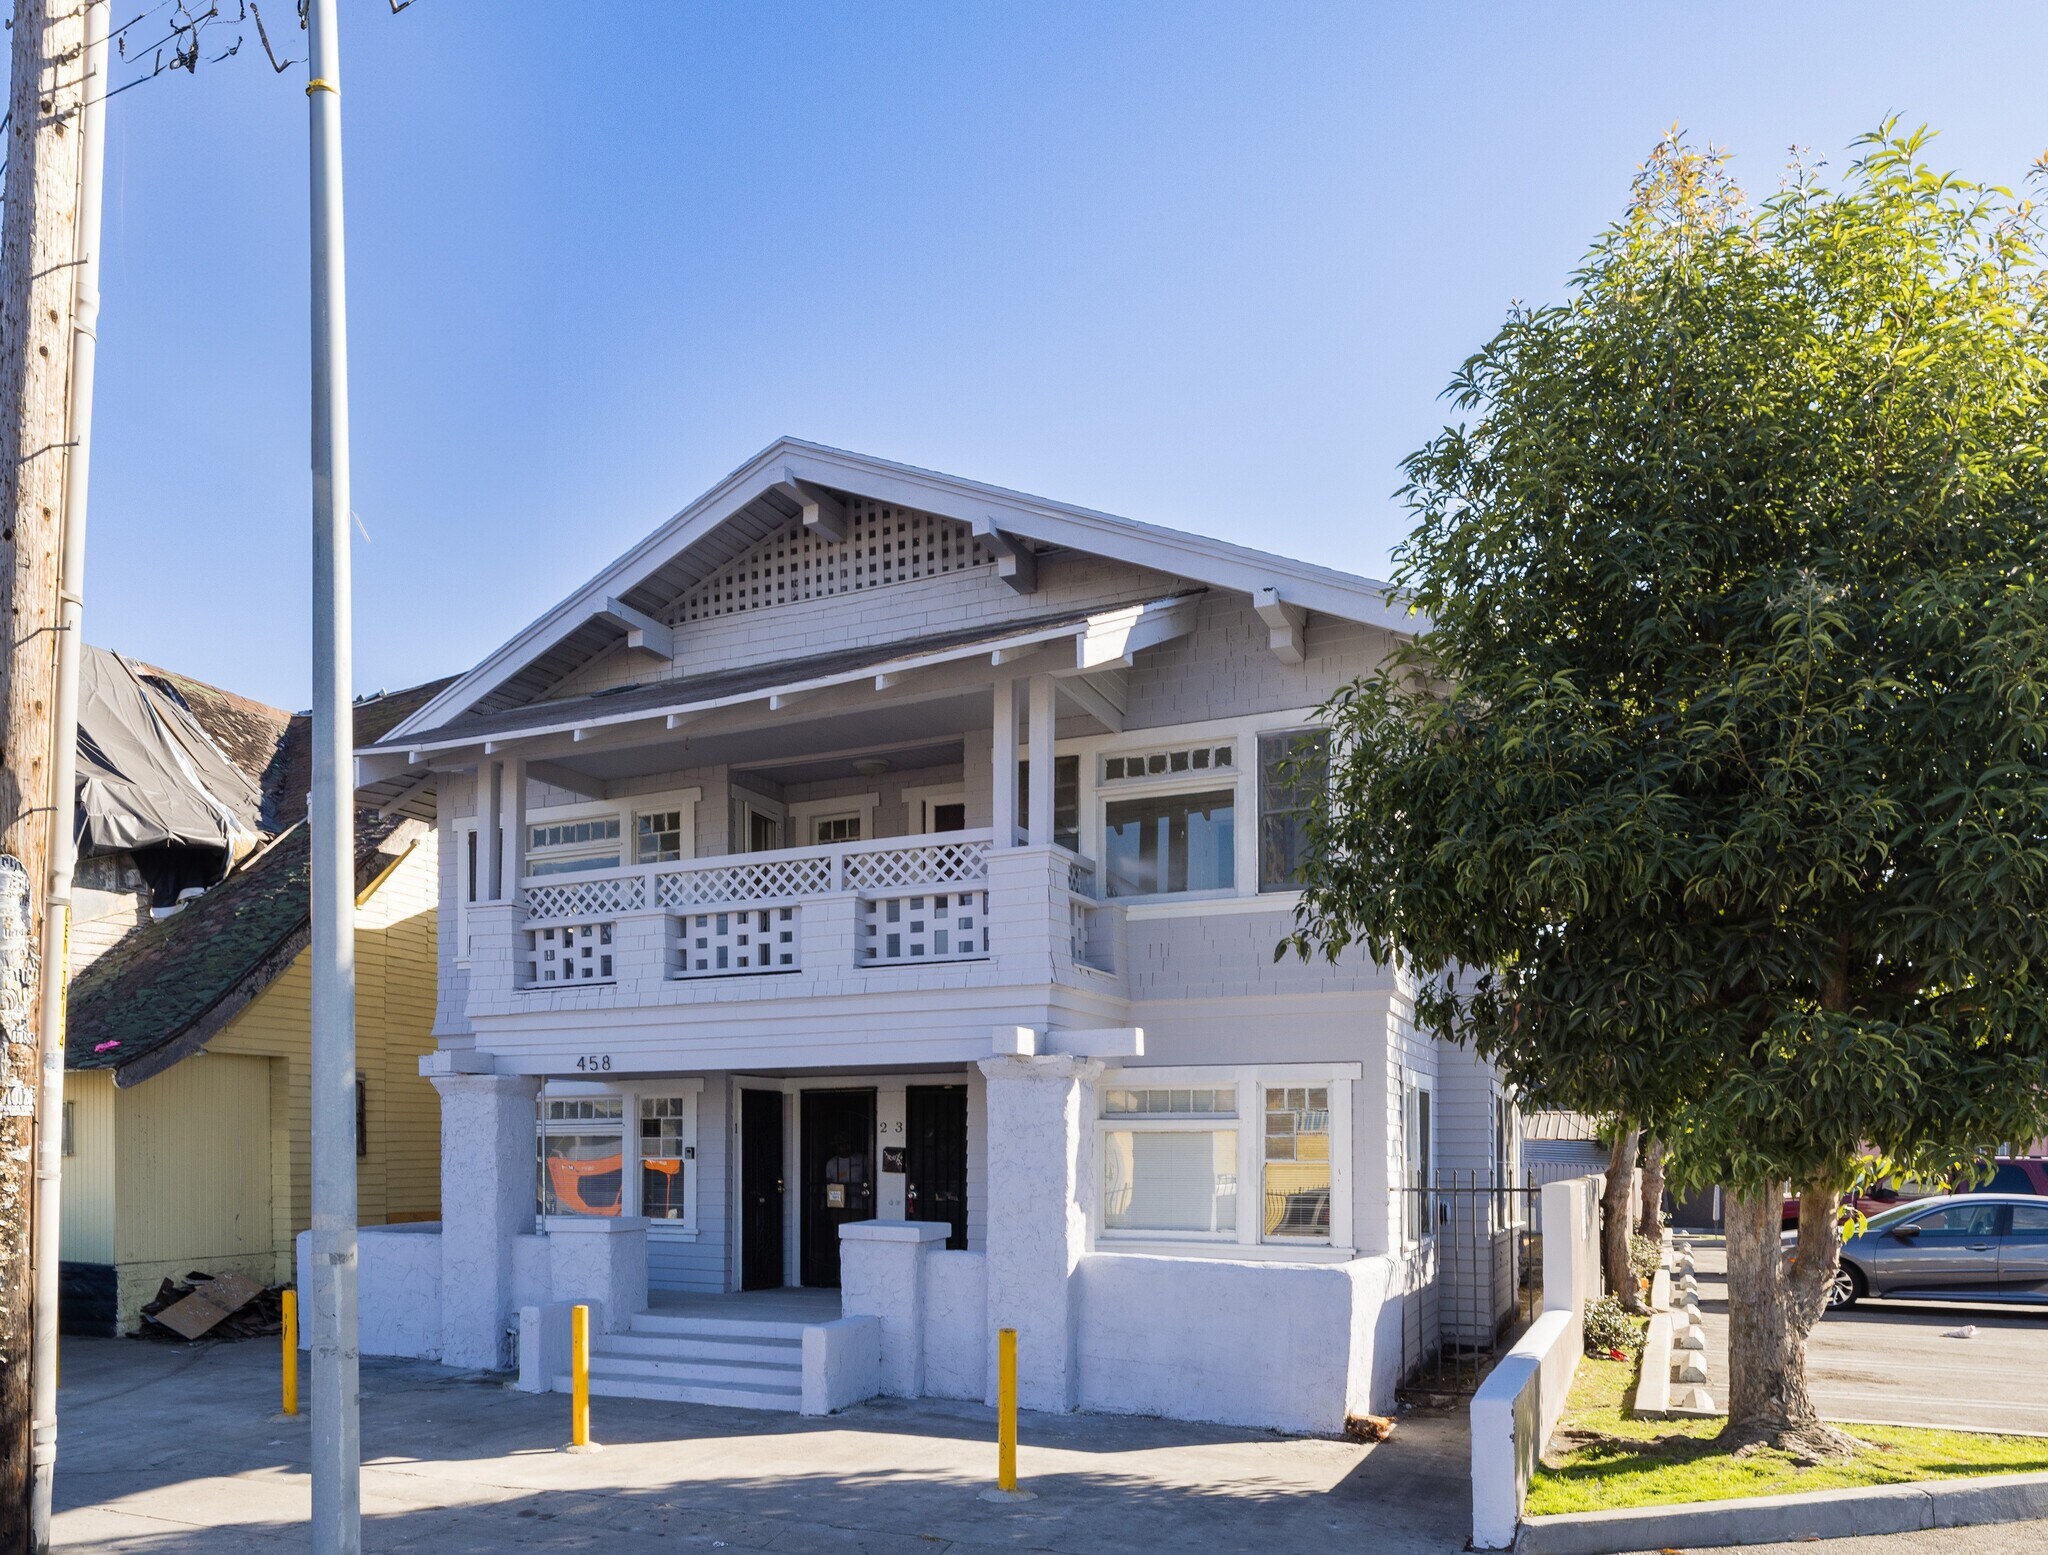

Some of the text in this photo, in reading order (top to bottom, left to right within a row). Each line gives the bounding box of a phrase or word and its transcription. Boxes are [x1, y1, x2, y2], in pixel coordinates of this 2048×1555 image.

[576, 1054, 611, 1072] 458
[879, 1121, 903, 1134] 2 3
